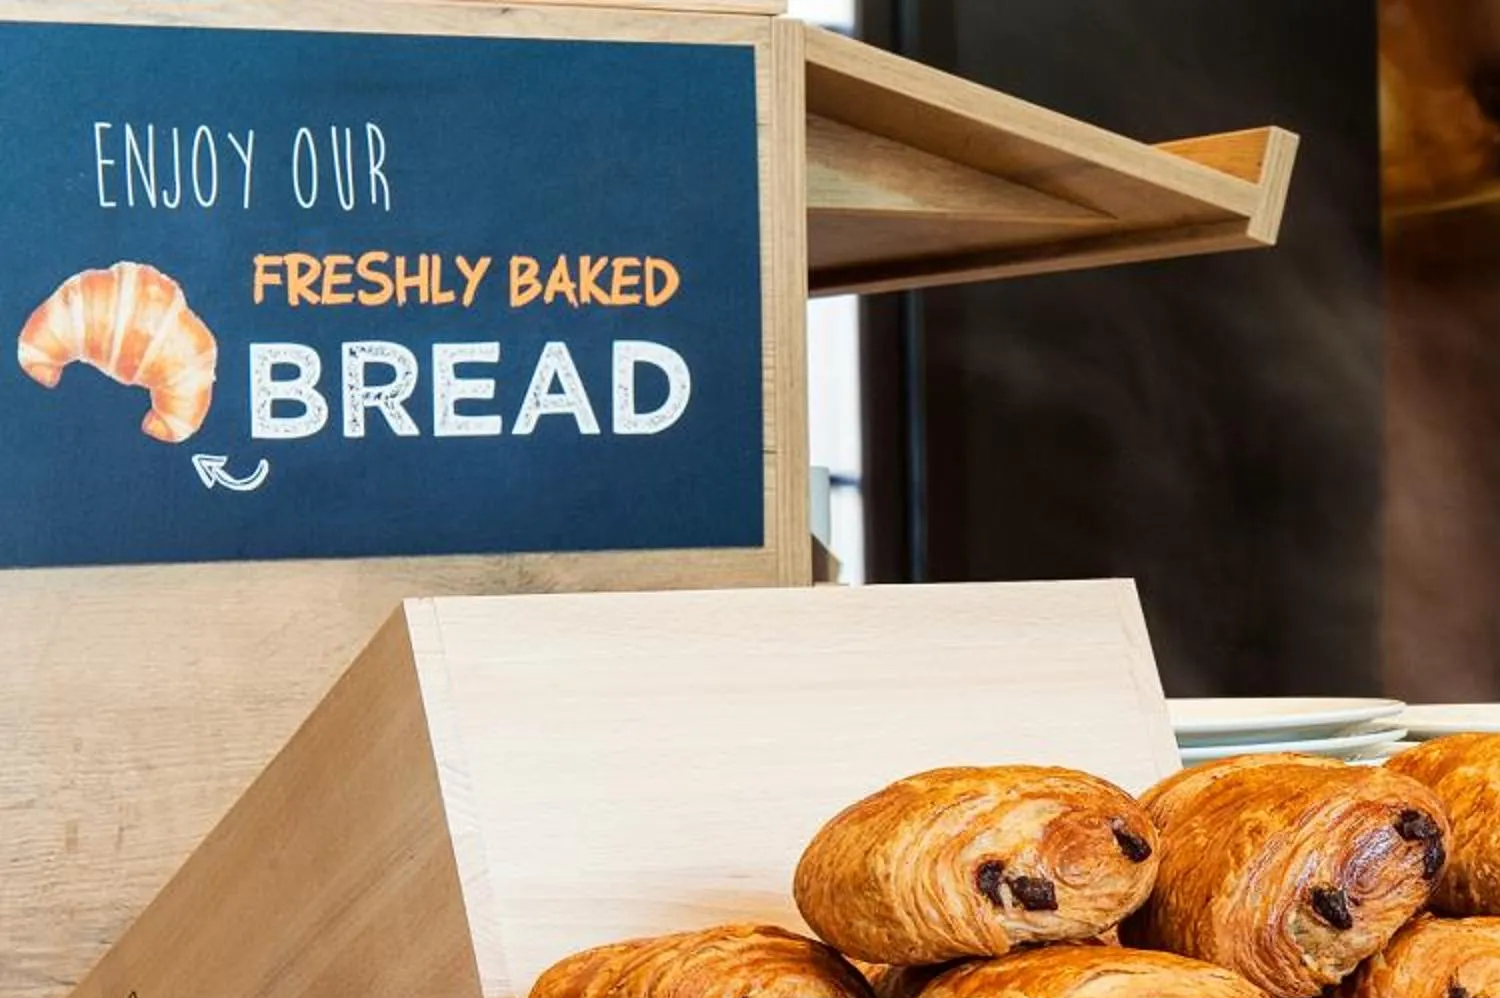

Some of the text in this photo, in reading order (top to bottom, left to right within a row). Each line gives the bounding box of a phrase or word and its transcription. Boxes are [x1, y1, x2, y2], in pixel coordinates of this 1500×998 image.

[95, 122, 391, 213] ENJOY OUR
[253, 252, 681, 310] FRESHLY BAKED
[249, 341, 693, 441] BREAD
